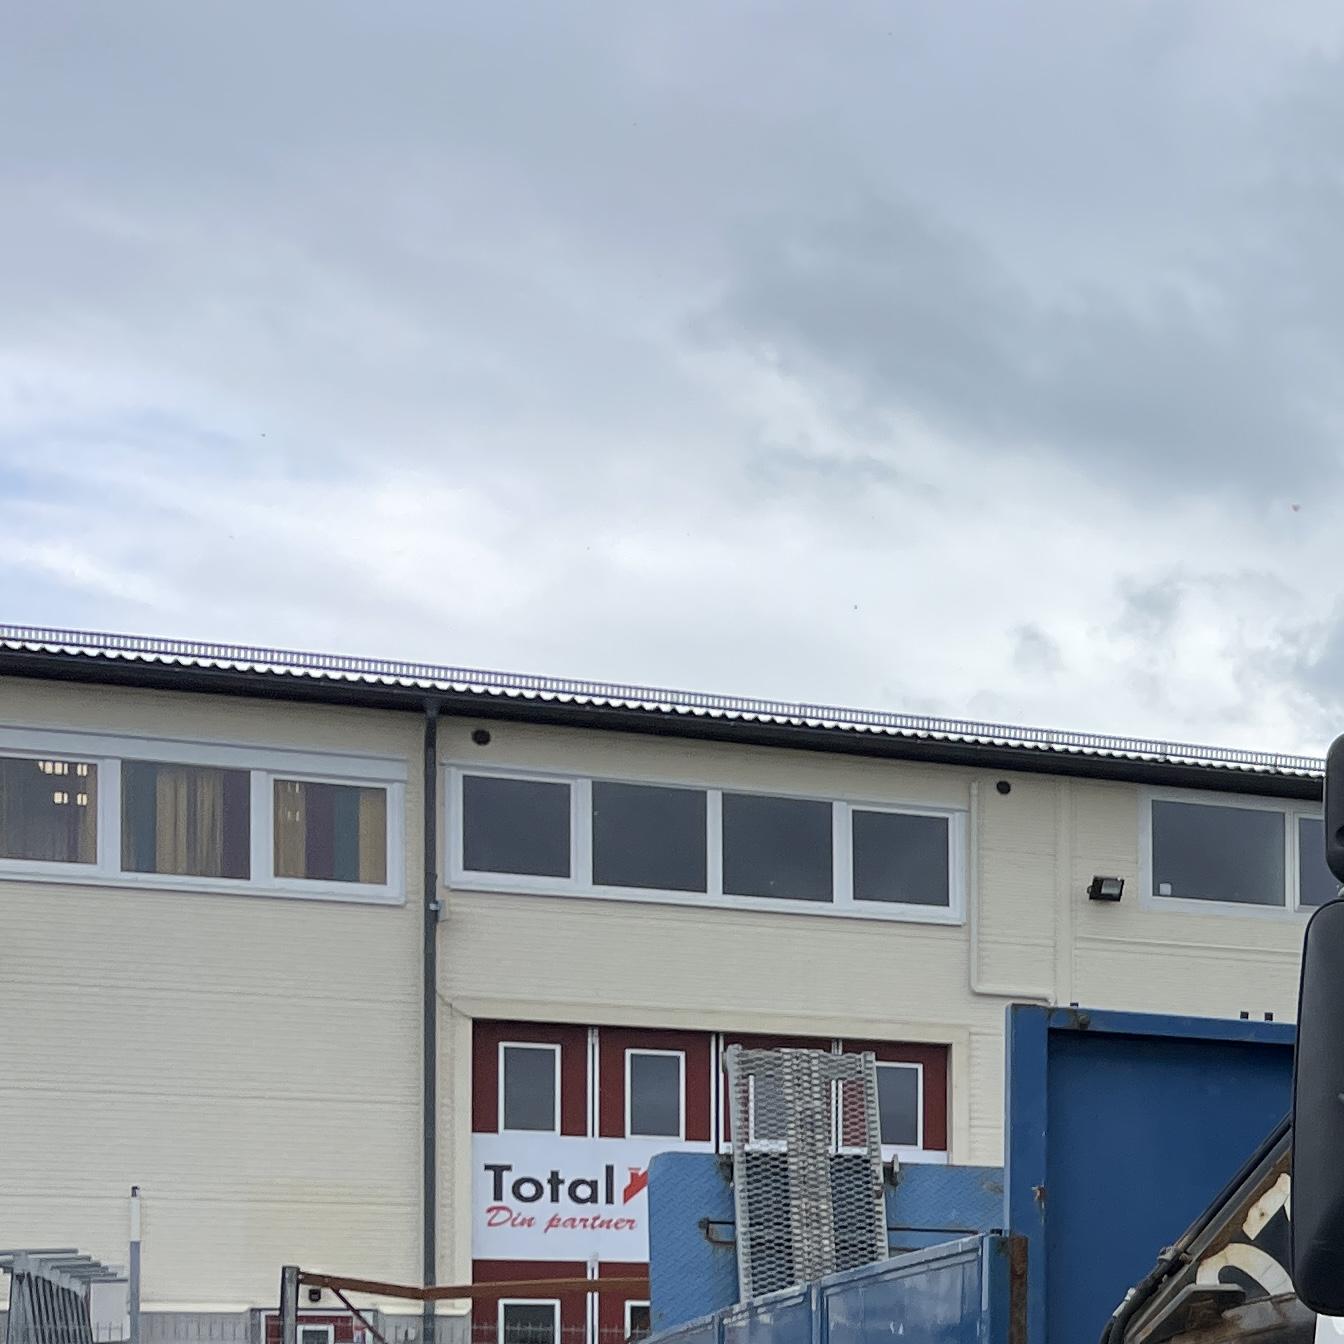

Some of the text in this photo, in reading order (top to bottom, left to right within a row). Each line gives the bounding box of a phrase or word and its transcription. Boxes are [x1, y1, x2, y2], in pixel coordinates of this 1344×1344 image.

[484, 1164, 614, 1205] Total
[486, 1205, 638, 1234] Din partner
